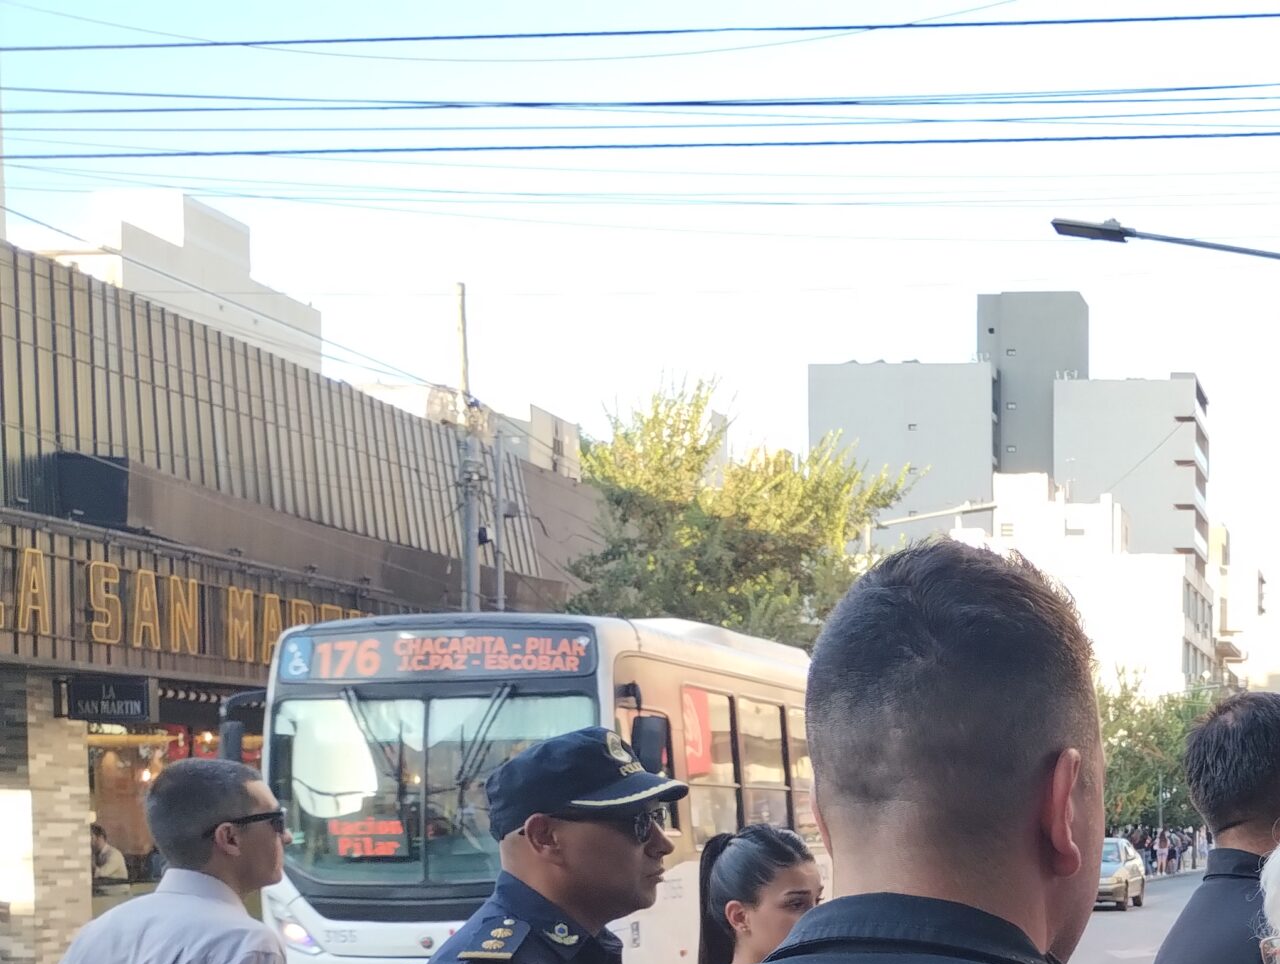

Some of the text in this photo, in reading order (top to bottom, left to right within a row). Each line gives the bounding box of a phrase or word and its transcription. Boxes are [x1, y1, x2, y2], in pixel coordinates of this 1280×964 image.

[0, 548, 50, 636] A
[89, 560, 198, 656] SAN
[525, 636, 587, 657] PILAR
[316, 637, 381, 678] 176
[484, 654, 580, 672] ESCOBAR
[100, 700, 142, 715] MARTIN
